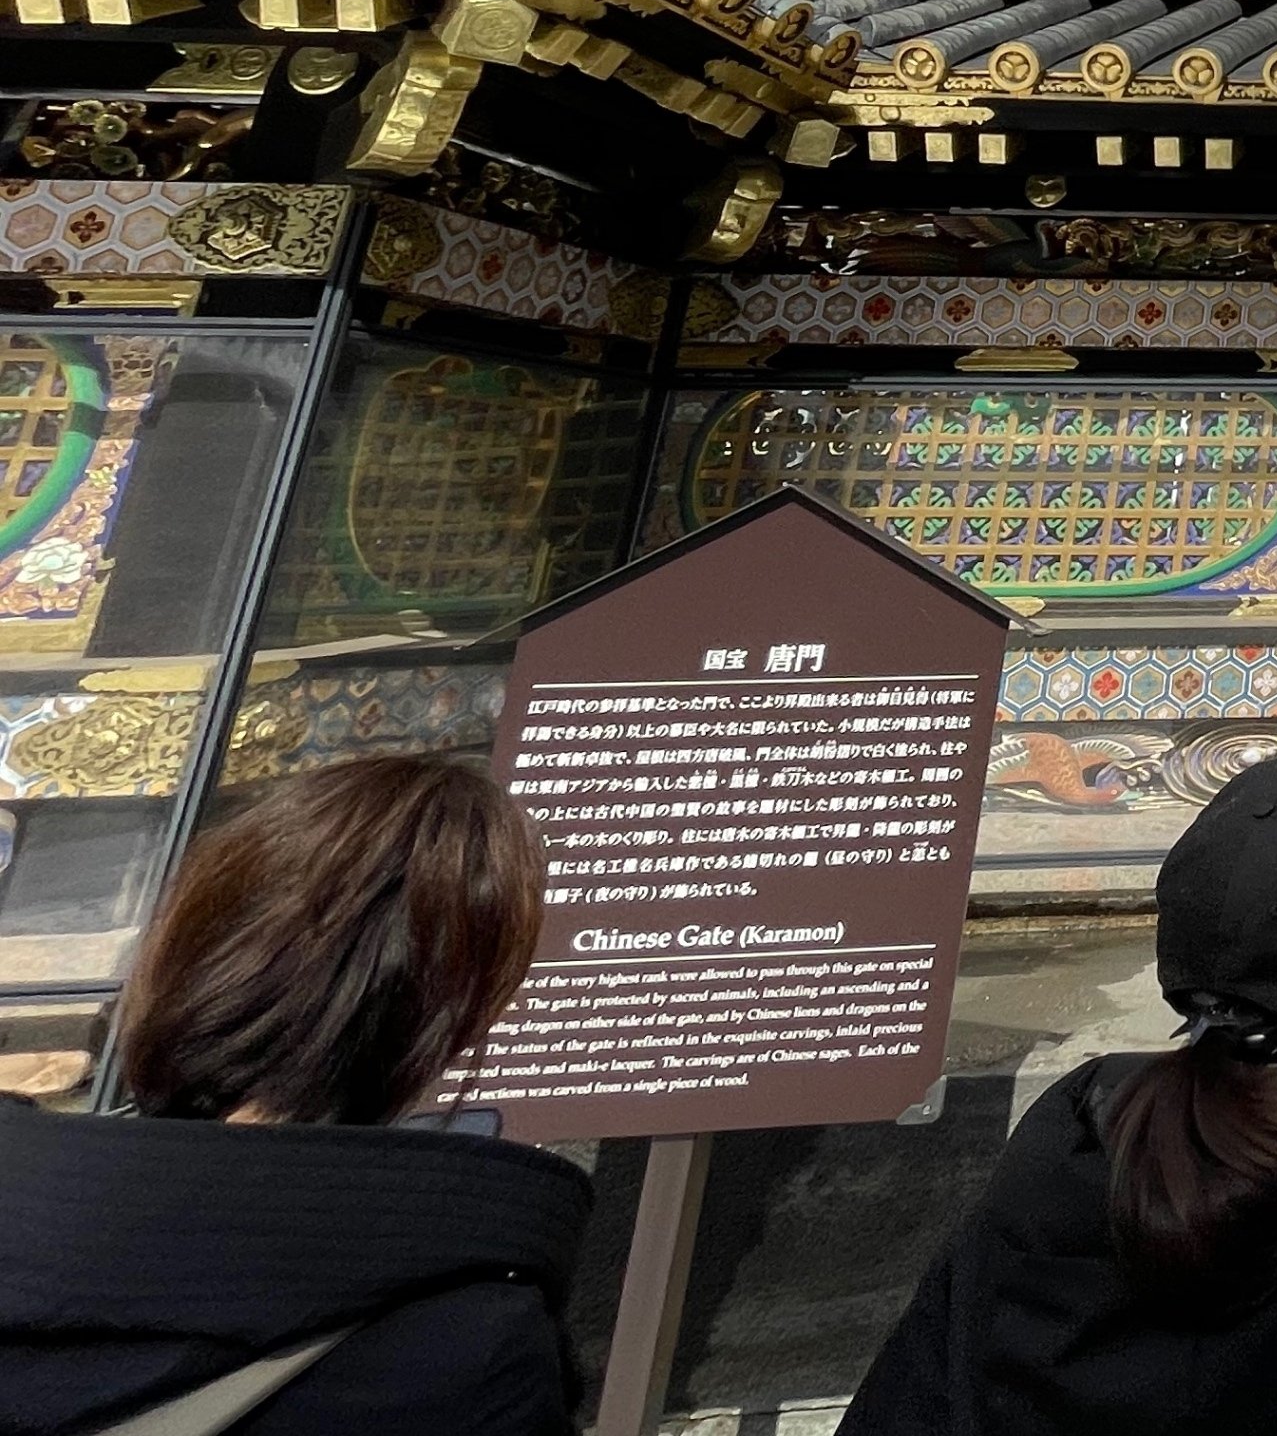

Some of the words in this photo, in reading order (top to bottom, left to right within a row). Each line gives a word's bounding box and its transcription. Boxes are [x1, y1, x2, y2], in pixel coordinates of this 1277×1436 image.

[703, 648, 748, 671] 国宝
[763, 643, 826, 673] 唐門
[572, 928, 673, 952] Chinese
[676, 924, 735, 947] Gate
[739, 921, 844, 949] (Karamon)
[534, 975, 550, 989] of
[549, 975, 570, 988] the
[571, 976, 598, 990] very
[597, 972, 641, 989] highest
[641, 970, 668, 984] rank
[670, 971, 699, 982] were
[698, 966, 746, 982] allowed
[745, 968, 759, 979] to
[757, 967, 785, 982] pass
[785, 962, 831, 979] through
[831, 961, 853, 974] this
[852, 961, 879, 976] gate
[878, 962, 895, 971] on
[895, 957, 934, 974] special
[526, 997, 551, 1011] The
[549, 997, 579, 1012] gate
[579, 996, 591, 1008] is
[592, 992, 651, 1011] protected
[652, 991, 669, 1008] by
[669, 989, 710, 1004] sacred
[709, 987, 761, 1002] animals,
[762, 984, 819, 1000] including
[819, 985, 836, 996] an
[836, 980, 896, 995] ascending
[896, 978, 921, 991] and
[921, 981, 930, 991] a
[520, 1019, 564, 1035] dragon
[563, 1020, 581, 1030] on
[581, 1015, 617, 1029] either
[616, 1014, 643, 1028] side
[642, 1012, 657, 1027] of
[656, 1012, 677, 1025] the
[675, 1013, 705, 1028] gate,
[705, 1009, 730, 1023] and
[729, 1009, 746, 1025] by
[746, 1007, 793, 1021] Chinese
[793, 1006, 821, 1018] lions
[821, 1003, 845, 1017] and
[845, 1002, 891, 1018] dragons
[891, 1003, 908, 1013] on
[908, 999, 928, 1012] the
[484, 1042, 510, 1056] The
[510, 1042, 549, 1055] status
[549, 1039, 566, 1053] of
[565, 1038, 588, 1052] the
[587, 1039, 617, 1054] gate
[616, 1036, 629, 1049] is
[630, 1033, 685, 1049] reflected
[685, 1033, 700, 1046] in
[701, 1031, 723, 1045] the
[722, 1029, 778, 1046] exquisite
[779, 1026, 834, 1042] carvings,
[835, 1023, 872, 1038] inlaid
[872, 1021, 923, 1038] precious
[442, 1064, 501, 1083] impted
[501, 1062, 541, 1077] woods
[542, 1061, 567, 1075] and
[567, 1059, 610, 1074] maki-e
[610, 1058, 656, 1073] lacquer.
[661, 1055, 685, 1069] The
[685, 1053, 735, 1069] carvings
[735, 1053, 756, 1064] are
[756, 1049, 771, 1063] of
[770, 1049, 818, 1062] Chinese
[818, 1048, 853, 1063] sages.
[857, 1043, 886, 1058] Each
[886, 1042, 902, 1055] of
[901, 1042, 921, 1055] the
[436, 1088, 480, 1104] cared
[479, 1087, 527, 1101] sections
[527, 1087, 552, 1098] was
[552, 1081, 594, 1097] carved
[593, 1081, 623, 1094] from
[622, 1082, 632, 1092] a
[632, 1077, 668, 1094] single
[667, 1077, 700, 1093] piece
[699, 1074, 715, 1088] of
[714, 1072, 749, 1087] wood.
